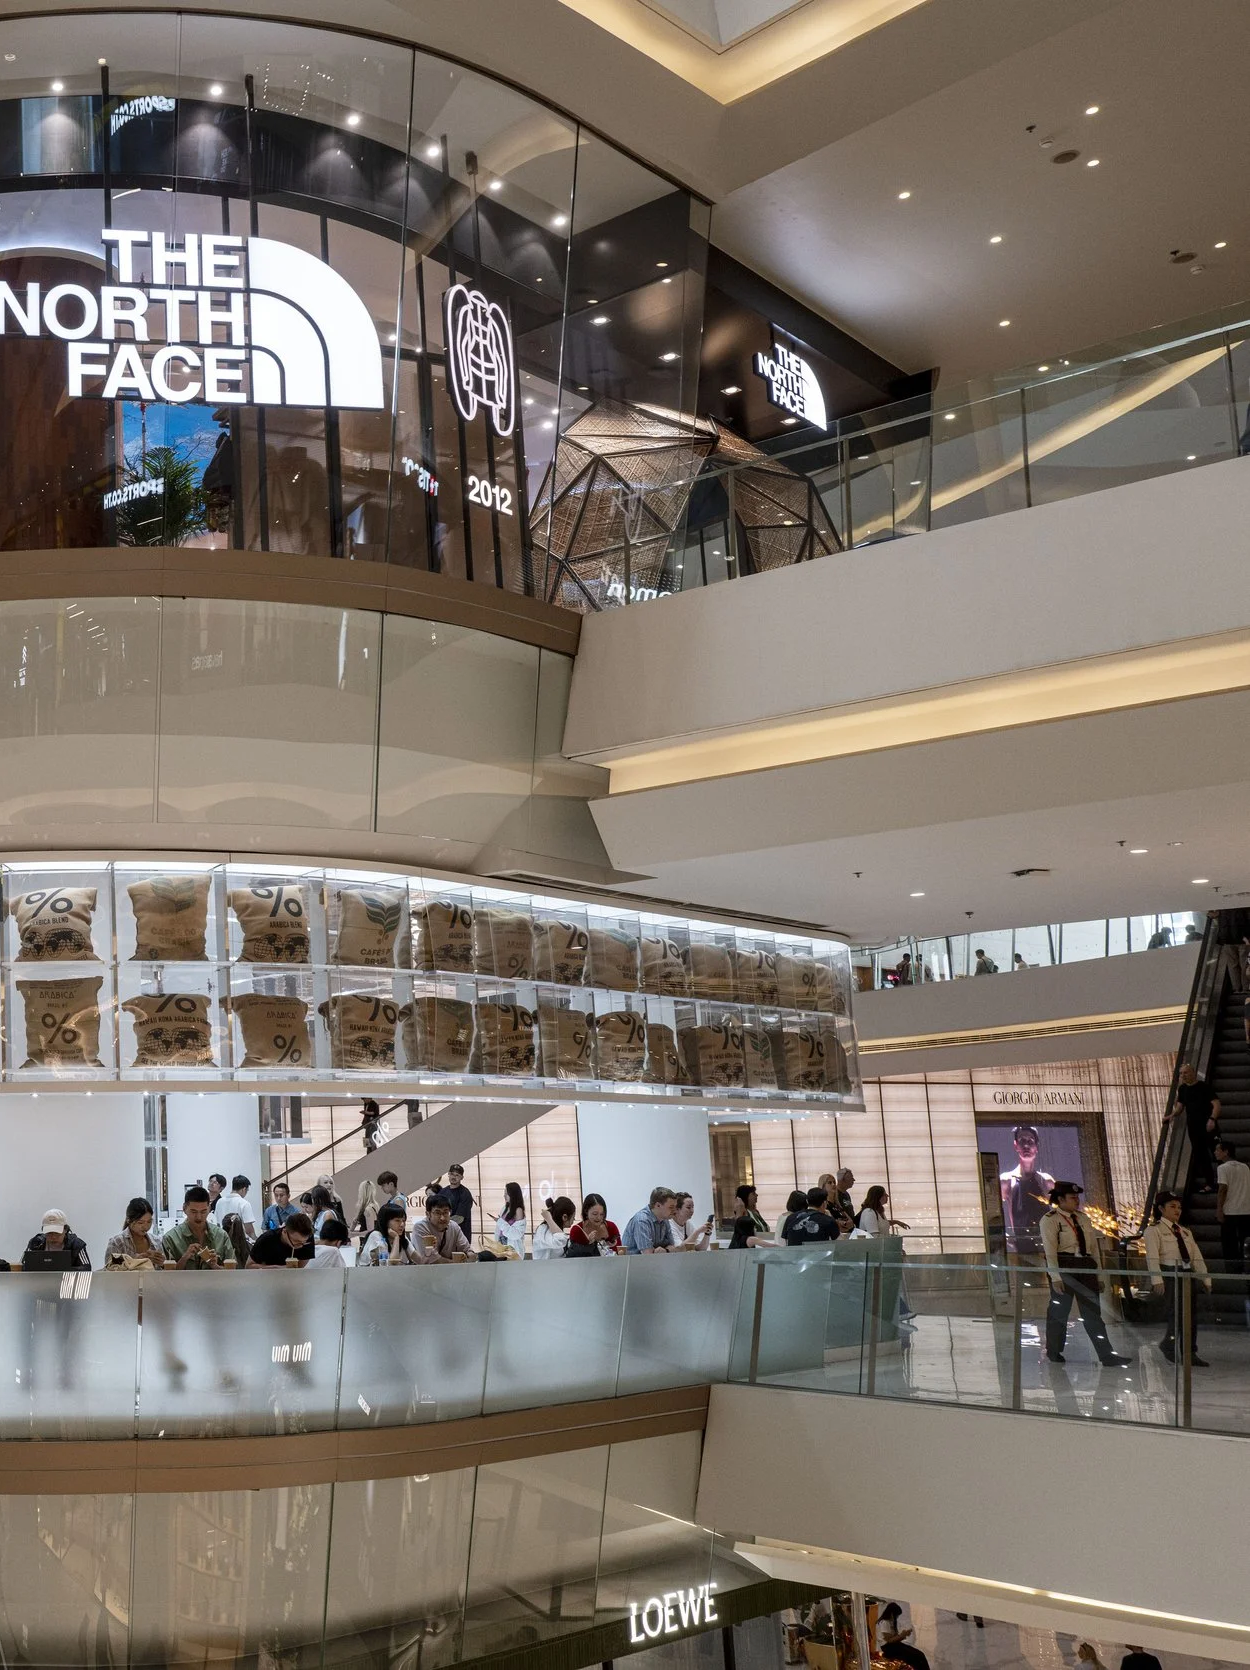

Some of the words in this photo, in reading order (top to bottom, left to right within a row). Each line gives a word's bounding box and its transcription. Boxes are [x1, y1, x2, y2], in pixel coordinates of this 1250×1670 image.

[102, 229, 244, 287] THE
[68, 342, 247, 403] FACE
[758, 352, 803, 397] NORTH
[775, 343, 801, 376] THE
[772, 381, 805, 418] FACE
[468, 476, 513, 516] 2012
[52, 916, 69, 924] BLEND
[39, 991, 74, 999] ARABICA
[41, 1013, 77, 1044] %
[273, 1034, 302, 1062] %
[993, 1091, 1040, 1106] GIORGIO
[1044, 1091, 1085, 1106] ARMANI
[630, 1582, 718, 1643] LOEWE
